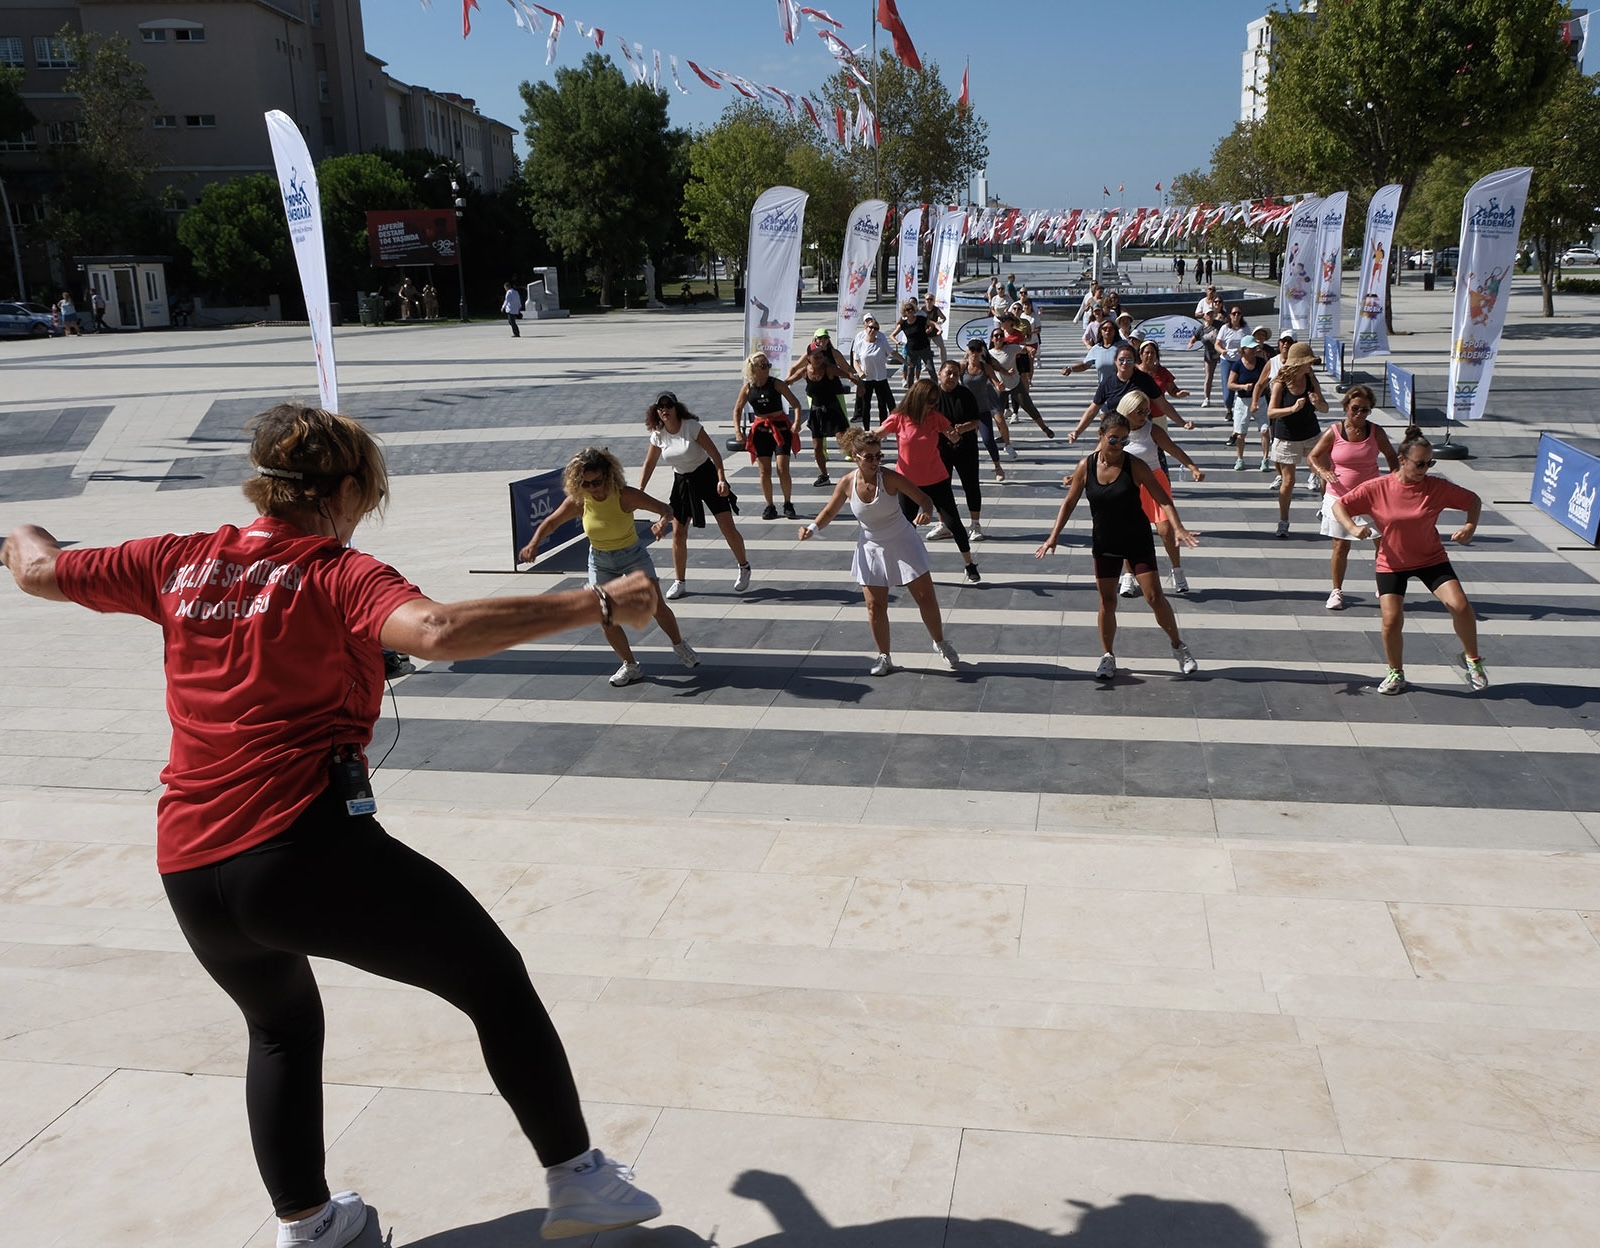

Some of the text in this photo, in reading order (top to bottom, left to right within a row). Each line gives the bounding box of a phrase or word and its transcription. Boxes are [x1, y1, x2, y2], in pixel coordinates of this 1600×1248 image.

[1482, 211, 1504, 219] SPOR
[378, 221, 404, 231] ZAFERİN
[378, 229, 405, 238] DESTANI
[756, 342, 783, 352] Crunch
[1463, 340, 1484, 349] SPOR
